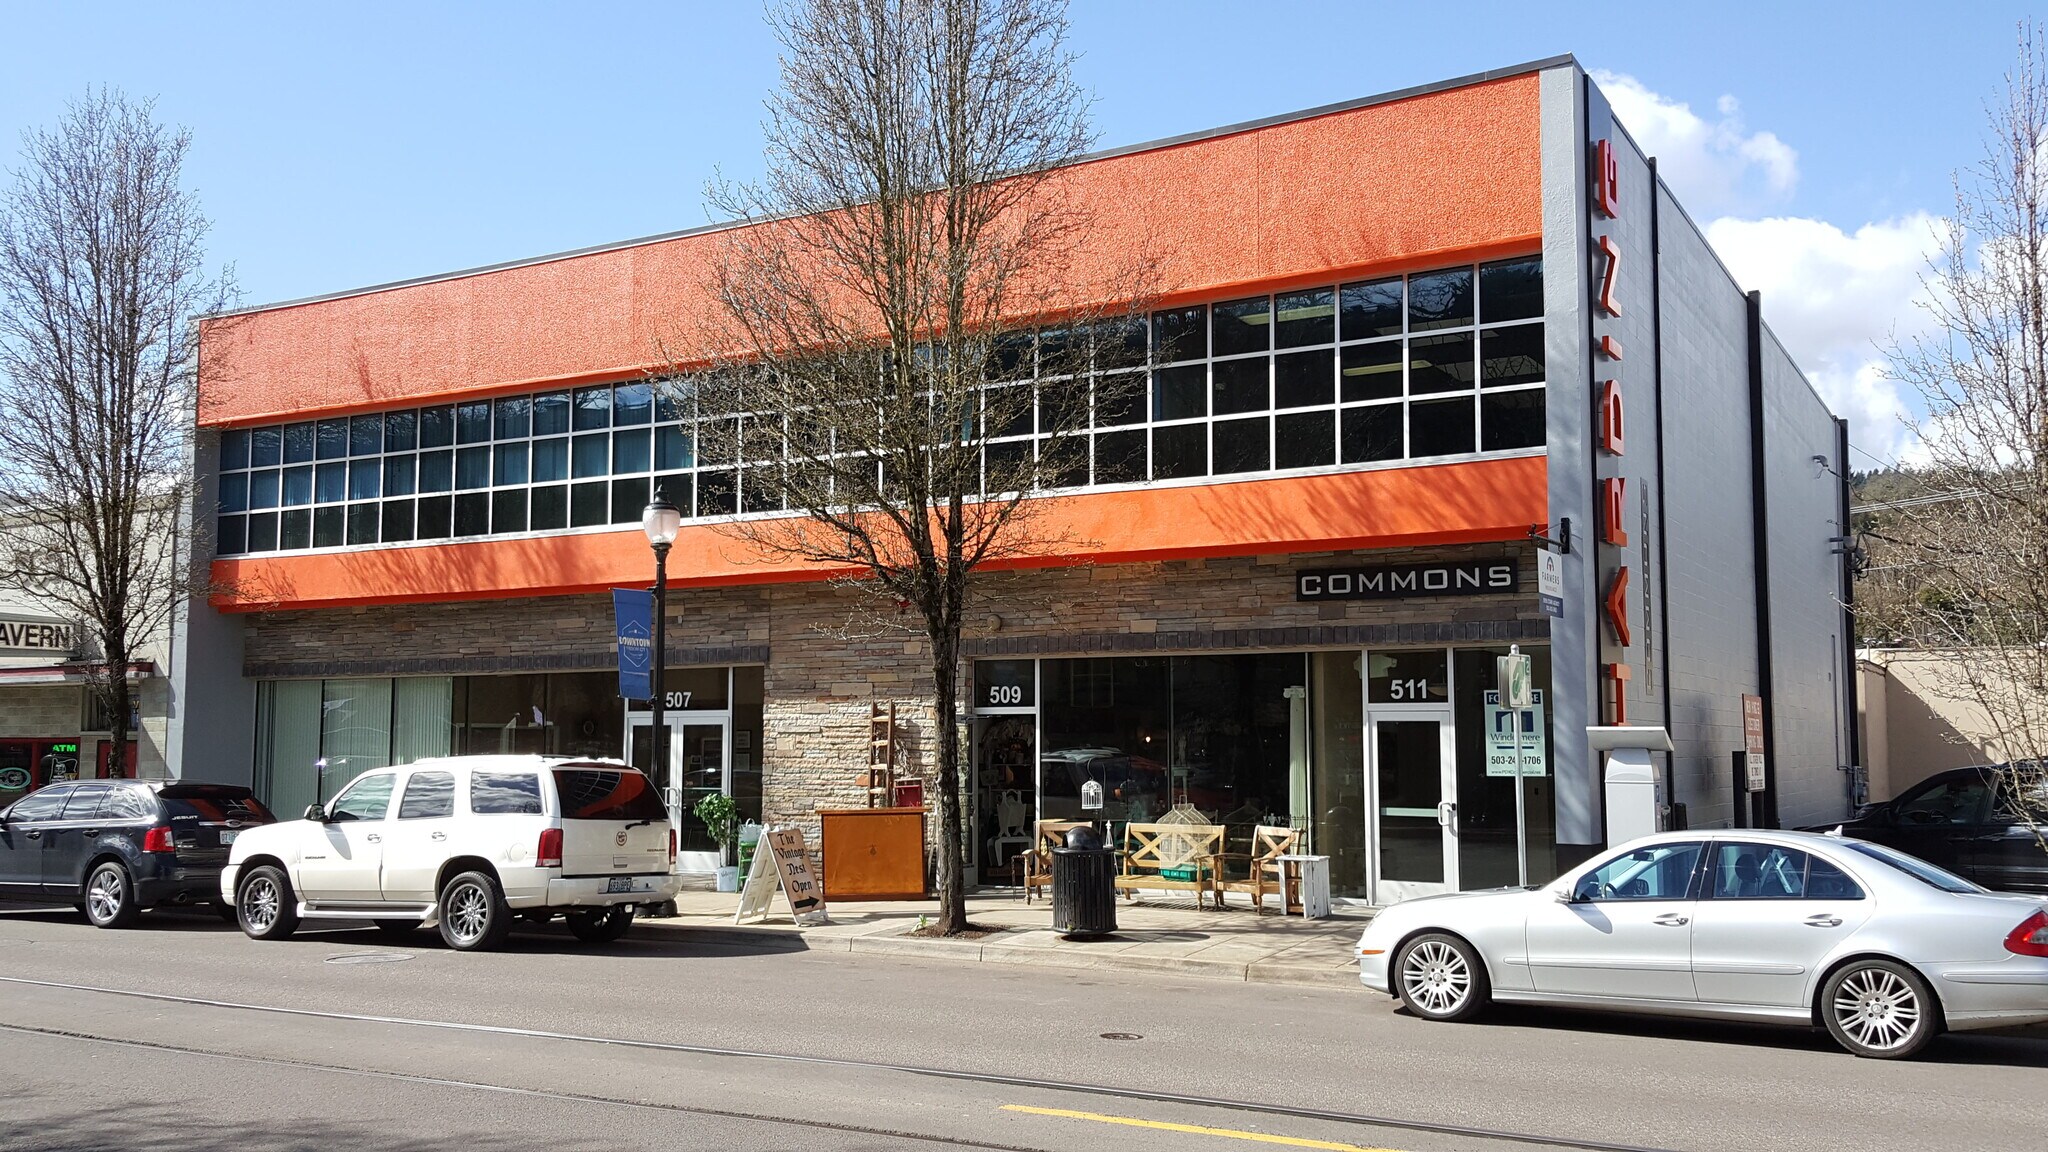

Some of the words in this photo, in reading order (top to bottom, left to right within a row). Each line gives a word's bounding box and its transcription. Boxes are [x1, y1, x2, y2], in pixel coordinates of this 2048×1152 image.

[1301, 566, 1512, 595] COMMONS
[1541, 571, 1560, 585] FARMERS
[1641, 482, 1653, 691] COMMONS
[0, 623, 70, 648] AVERN
[618, 636, 651, 648] DOWNTOWN
[989, 685, 1022, 704] 509
[1390, 679, 1427, 700] 511
[665, 691, 692, 708] 507
[1488, 694, 1500, 703] FO
[1490, 733, 1541, 742] Windemere
[52, 744, 77, 752] ATM
[1491, 755, 1542, 765] 503-24-1706
[777, 833, 795, 845] The
[775, 847, 806, 860] Vintage
[786, 863, 807, 876] Nest
[791, 880, 813, 894] Open
